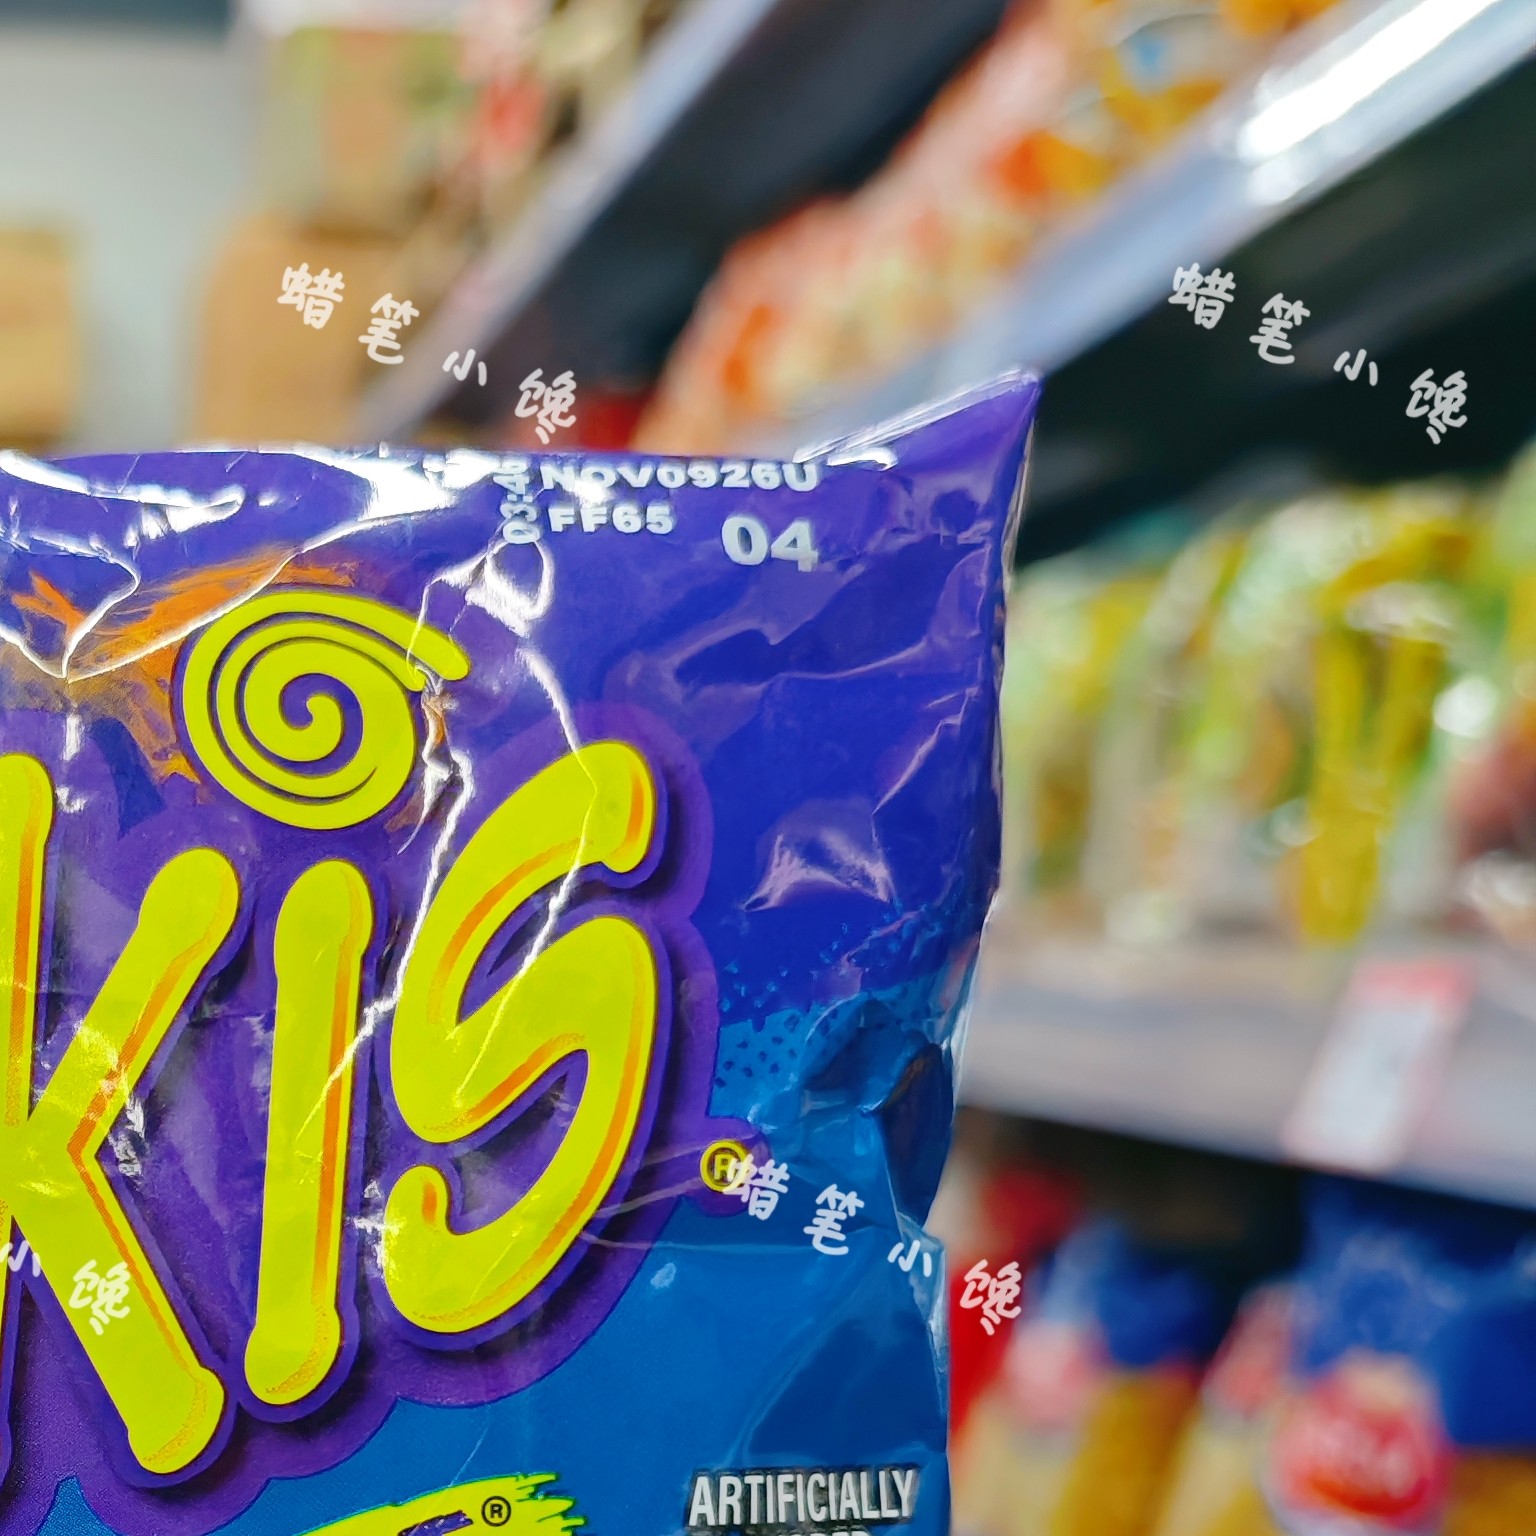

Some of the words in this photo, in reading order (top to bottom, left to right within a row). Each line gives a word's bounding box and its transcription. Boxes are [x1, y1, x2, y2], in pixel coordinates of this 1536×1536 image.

[548, 503, 674, 535] FF65
[722, 513, 819, 572] 04
[688, 1469, 915, 1527] ARTIFICIALLY
